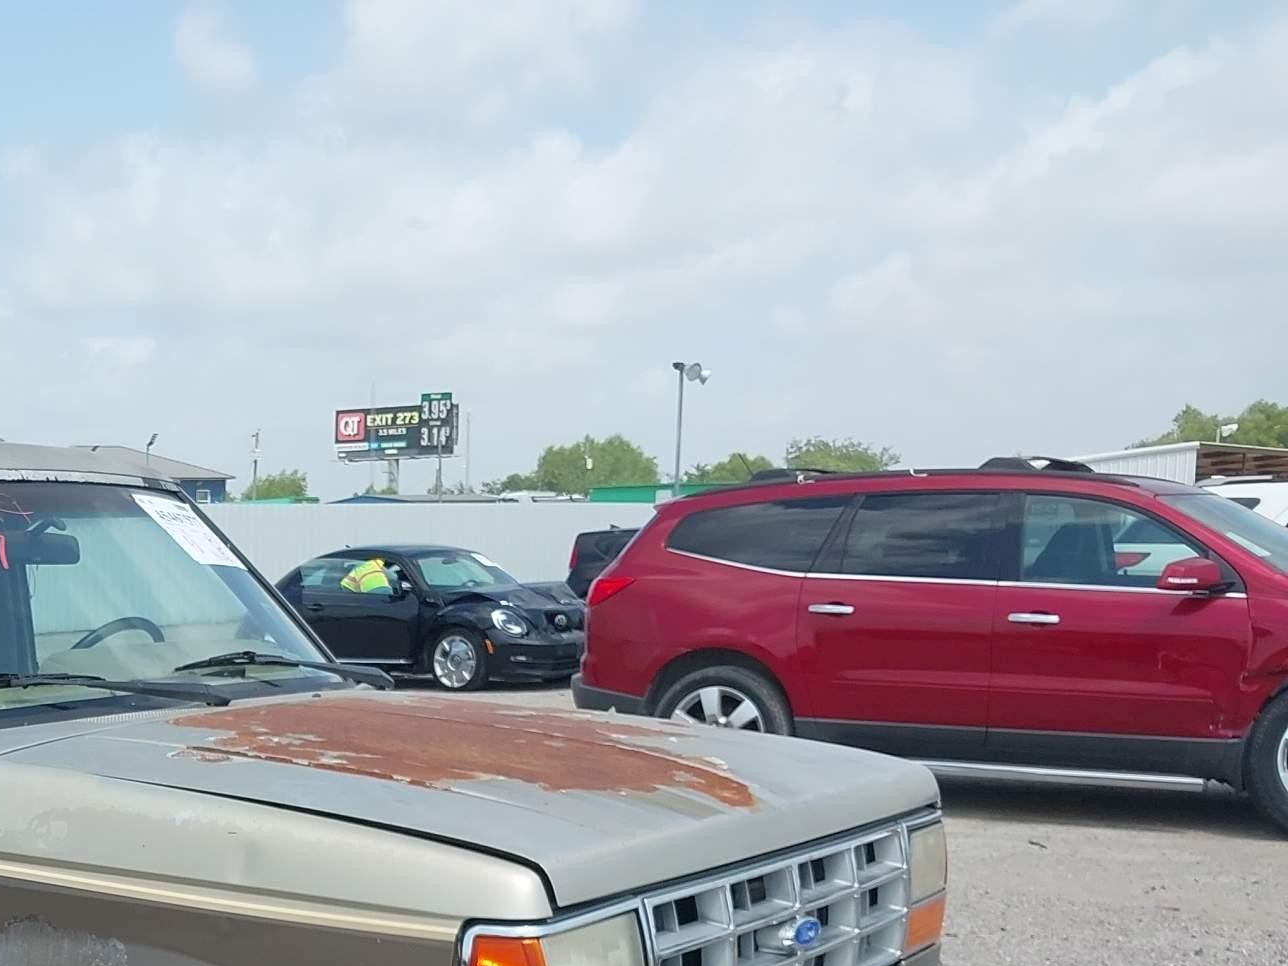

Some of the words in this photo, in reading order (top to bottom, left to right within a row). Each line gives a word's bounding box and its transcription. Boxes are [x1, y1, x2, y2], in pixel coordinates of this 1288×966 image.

[340, 416, 361, 437] QT
[366, 413, 394, 426] EXIT
[396, 411, 419, 424] 273
